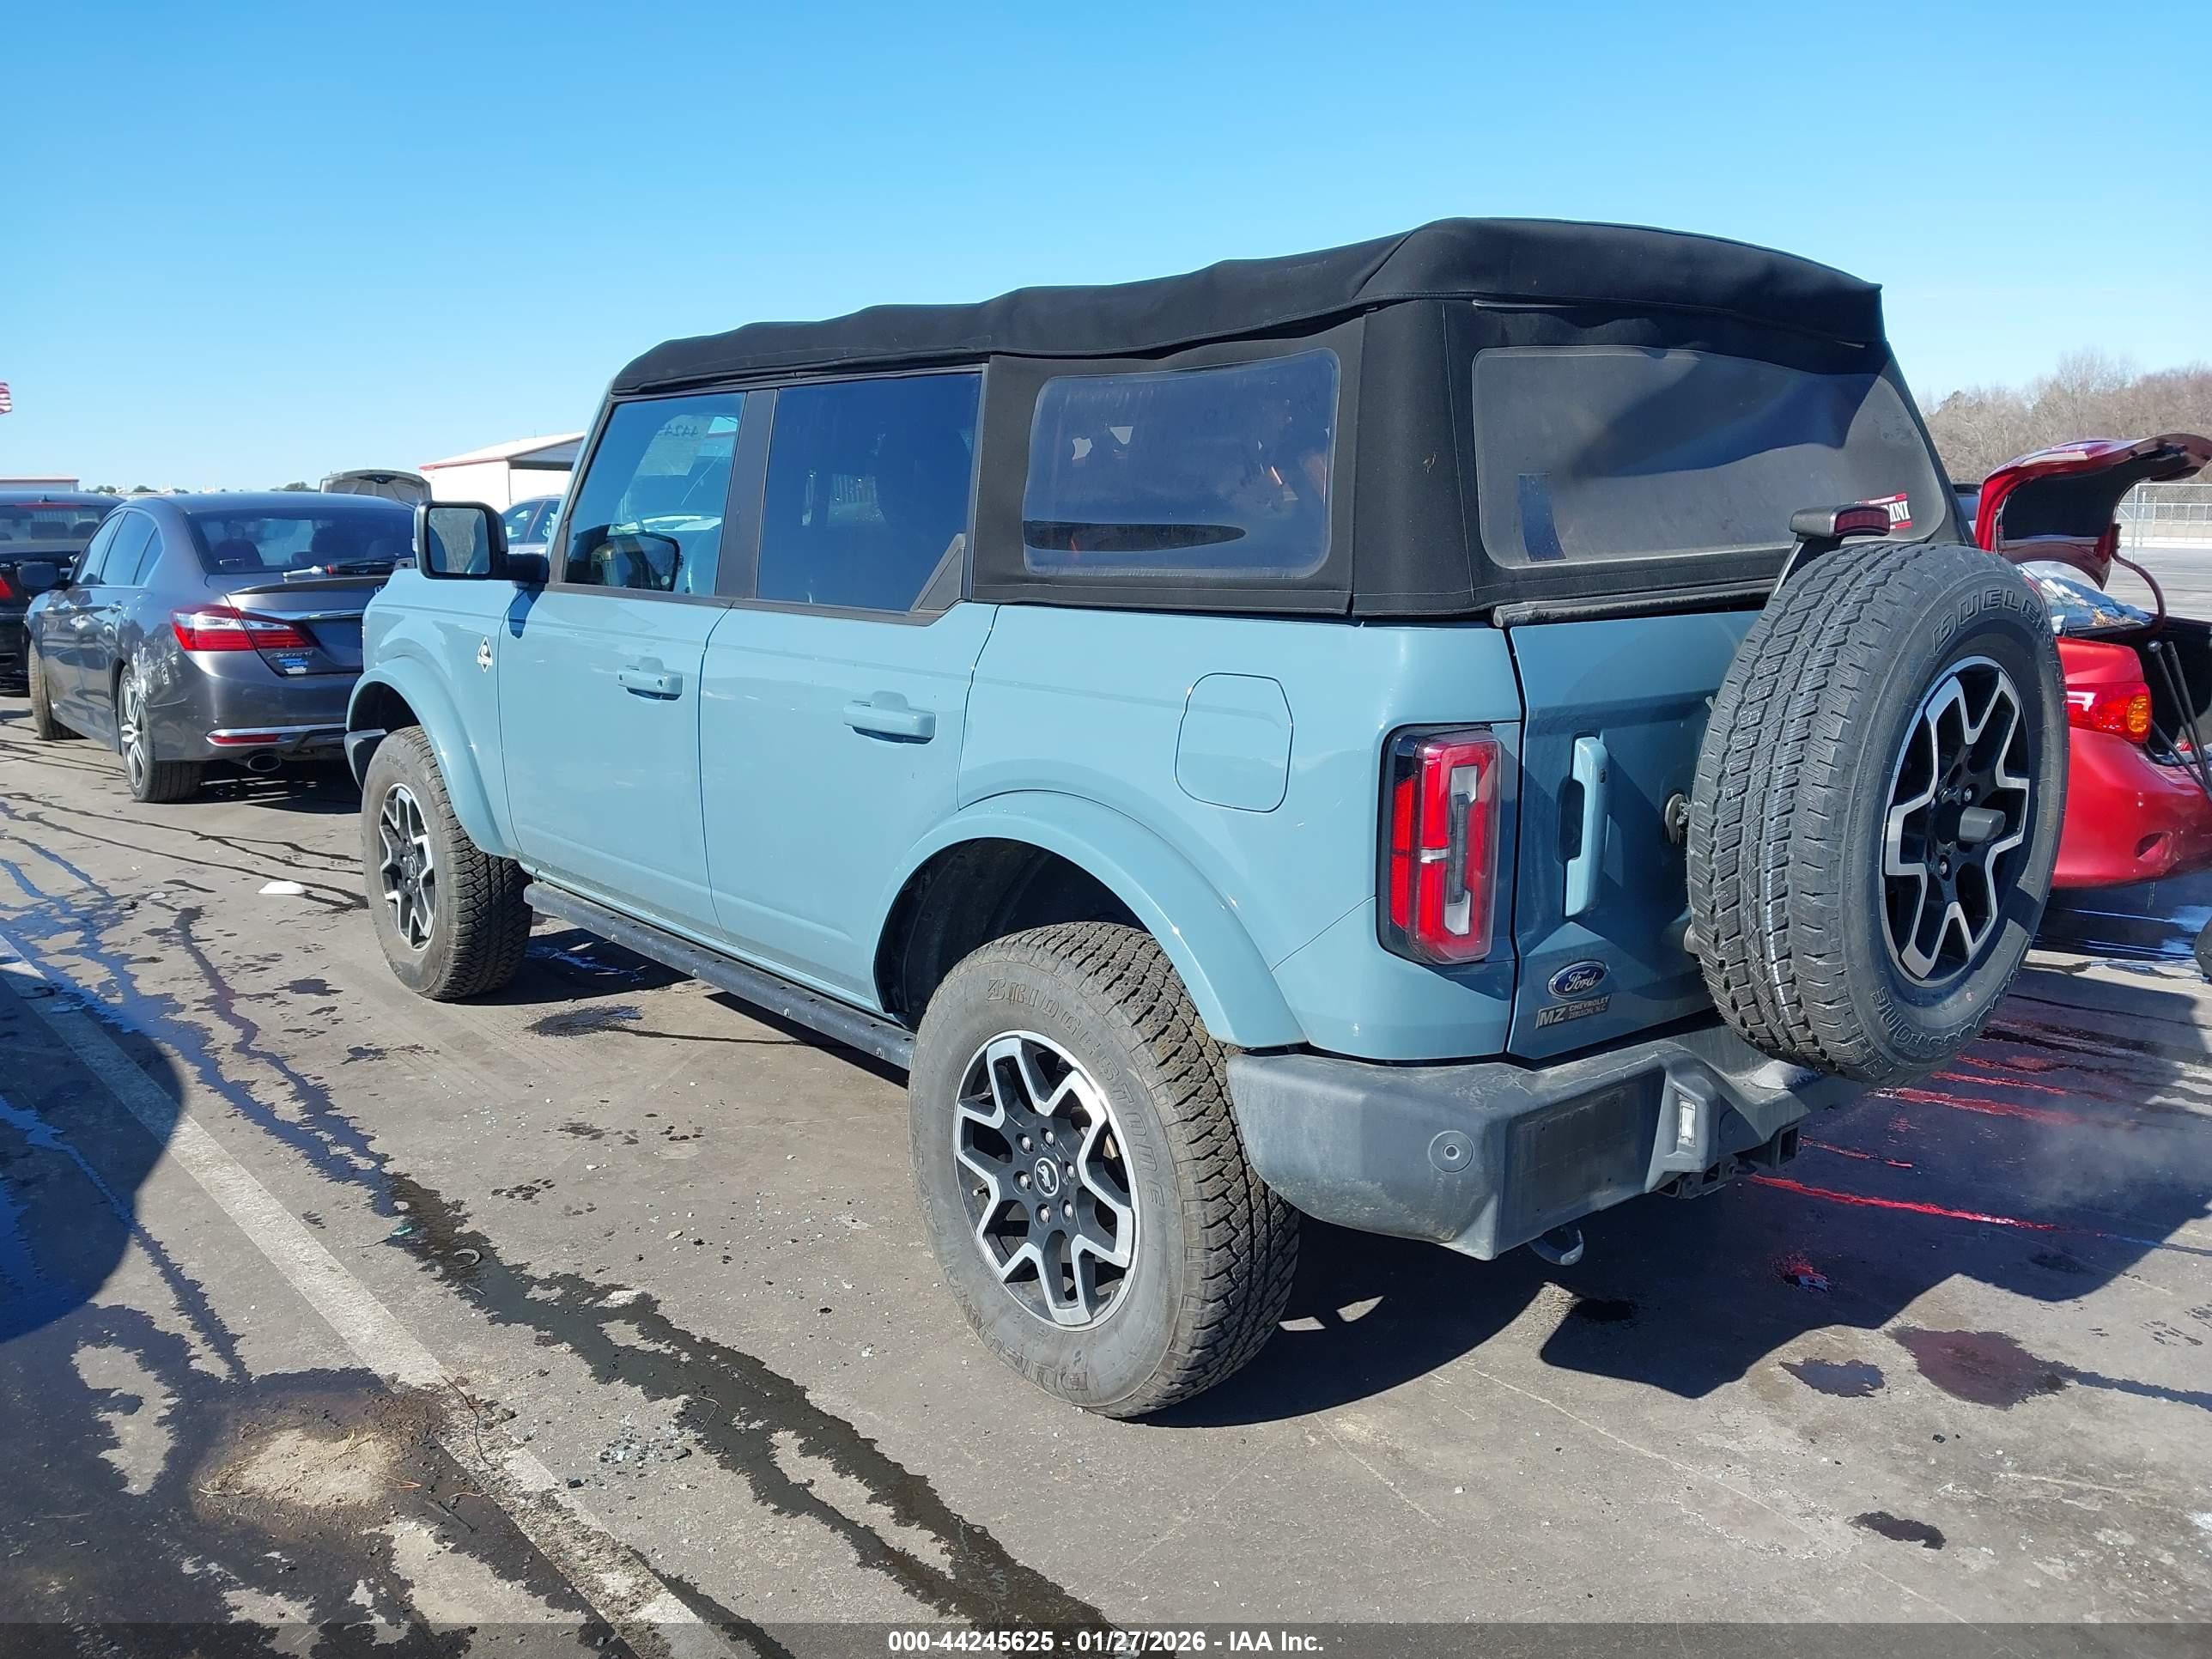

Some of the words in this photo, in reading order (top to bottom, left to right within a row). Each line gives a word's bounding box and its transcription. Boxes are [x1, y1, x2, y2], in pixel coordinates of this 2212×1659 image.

[1565, 969, 1597, 992] Ford
[1569, 996, 1610, 1011] CHEVROLET
[1540, 1007, 1566, 1026] MZ
[987, 977, 1165, 1208] BRIDGESTONE
